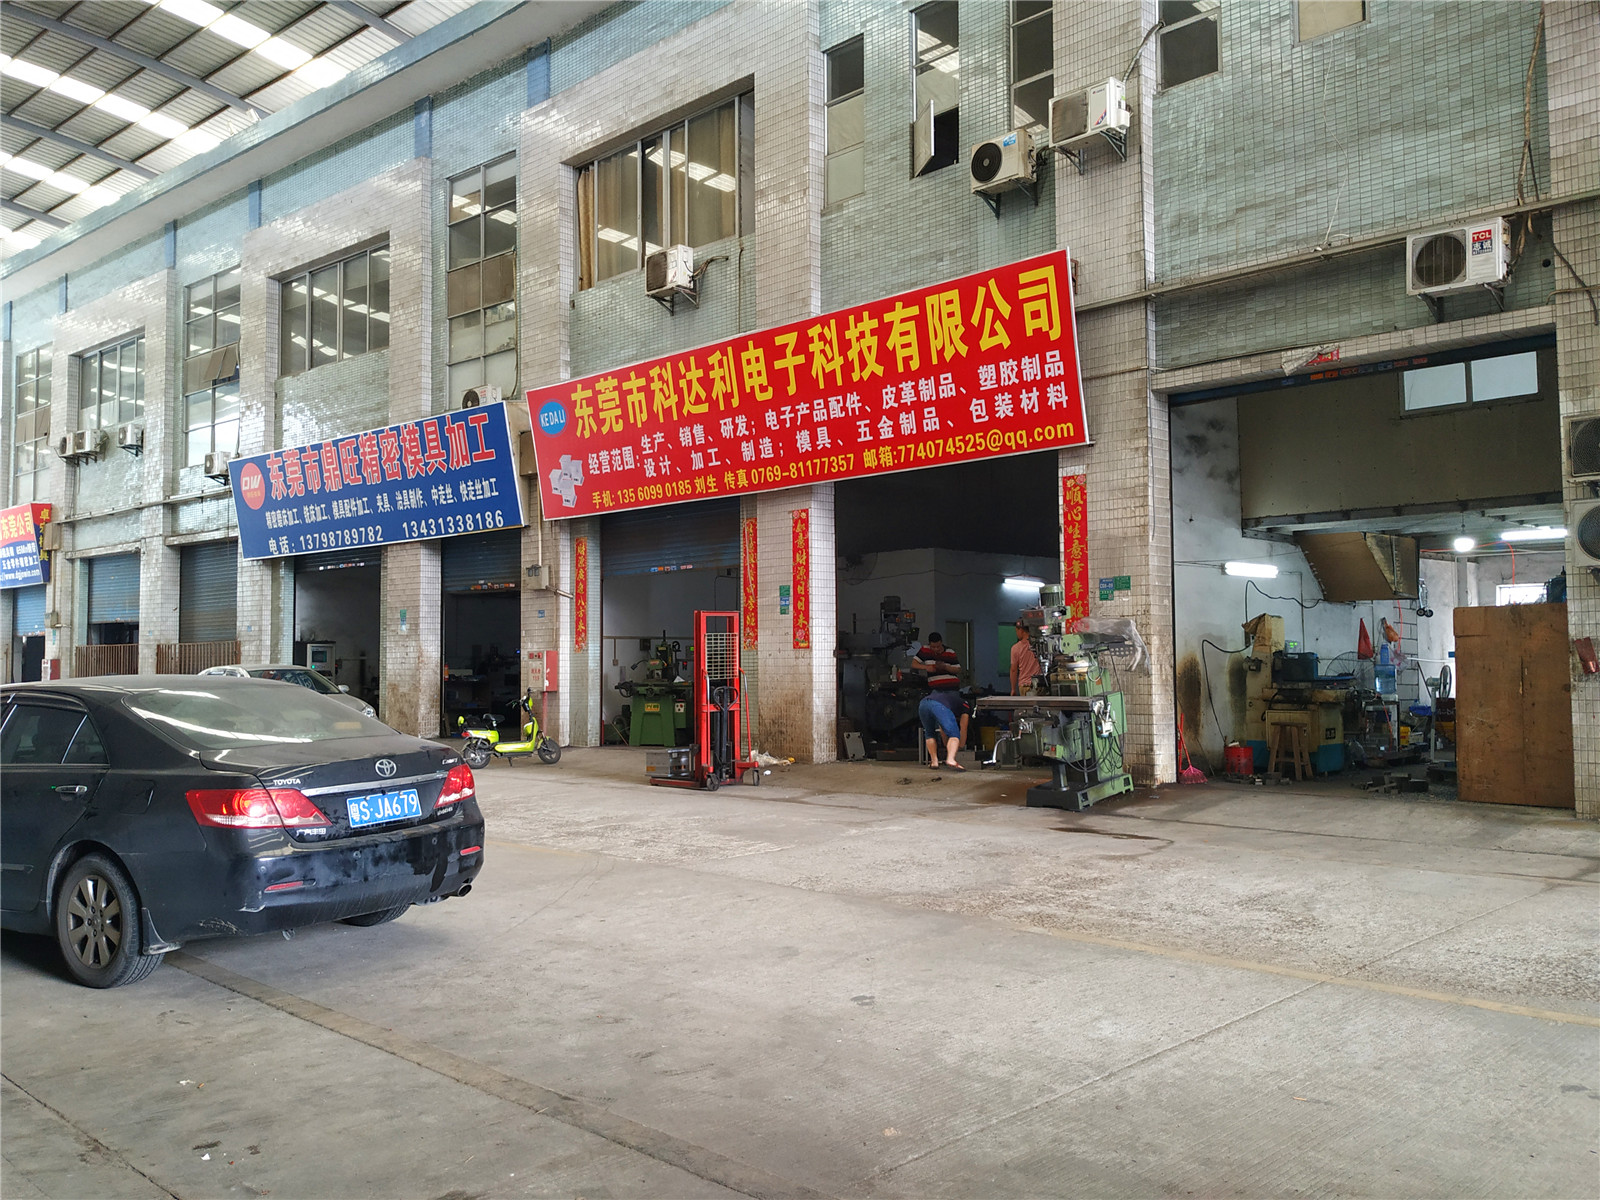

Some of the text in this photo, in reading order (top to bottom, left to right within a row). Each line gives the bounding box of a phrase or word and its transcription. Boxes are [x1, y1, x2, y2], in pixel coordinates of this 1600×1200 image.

[1472, 231, 1491, 240] TCL
[571, 264, 1062, 439] 东莞市科达利电子科技有限公司
[266, 412, 497, 500] 东莞市鼎旺精密模具加工
[616, 489, 635, 504] 135
[637, 484, 663, 501] 6099
[665, 479, 692, 498] 0185
[695, 476, 719, 495] 刘生
[0, 511, 34, 540] 东莞公司
[299, 525, 384, 551] 13798789782
[402, 509, 504, 538] 13431338186
[273, 778, 301, 786] TOYOTA
[350, 793, 417, 822] 粤S·JA679
